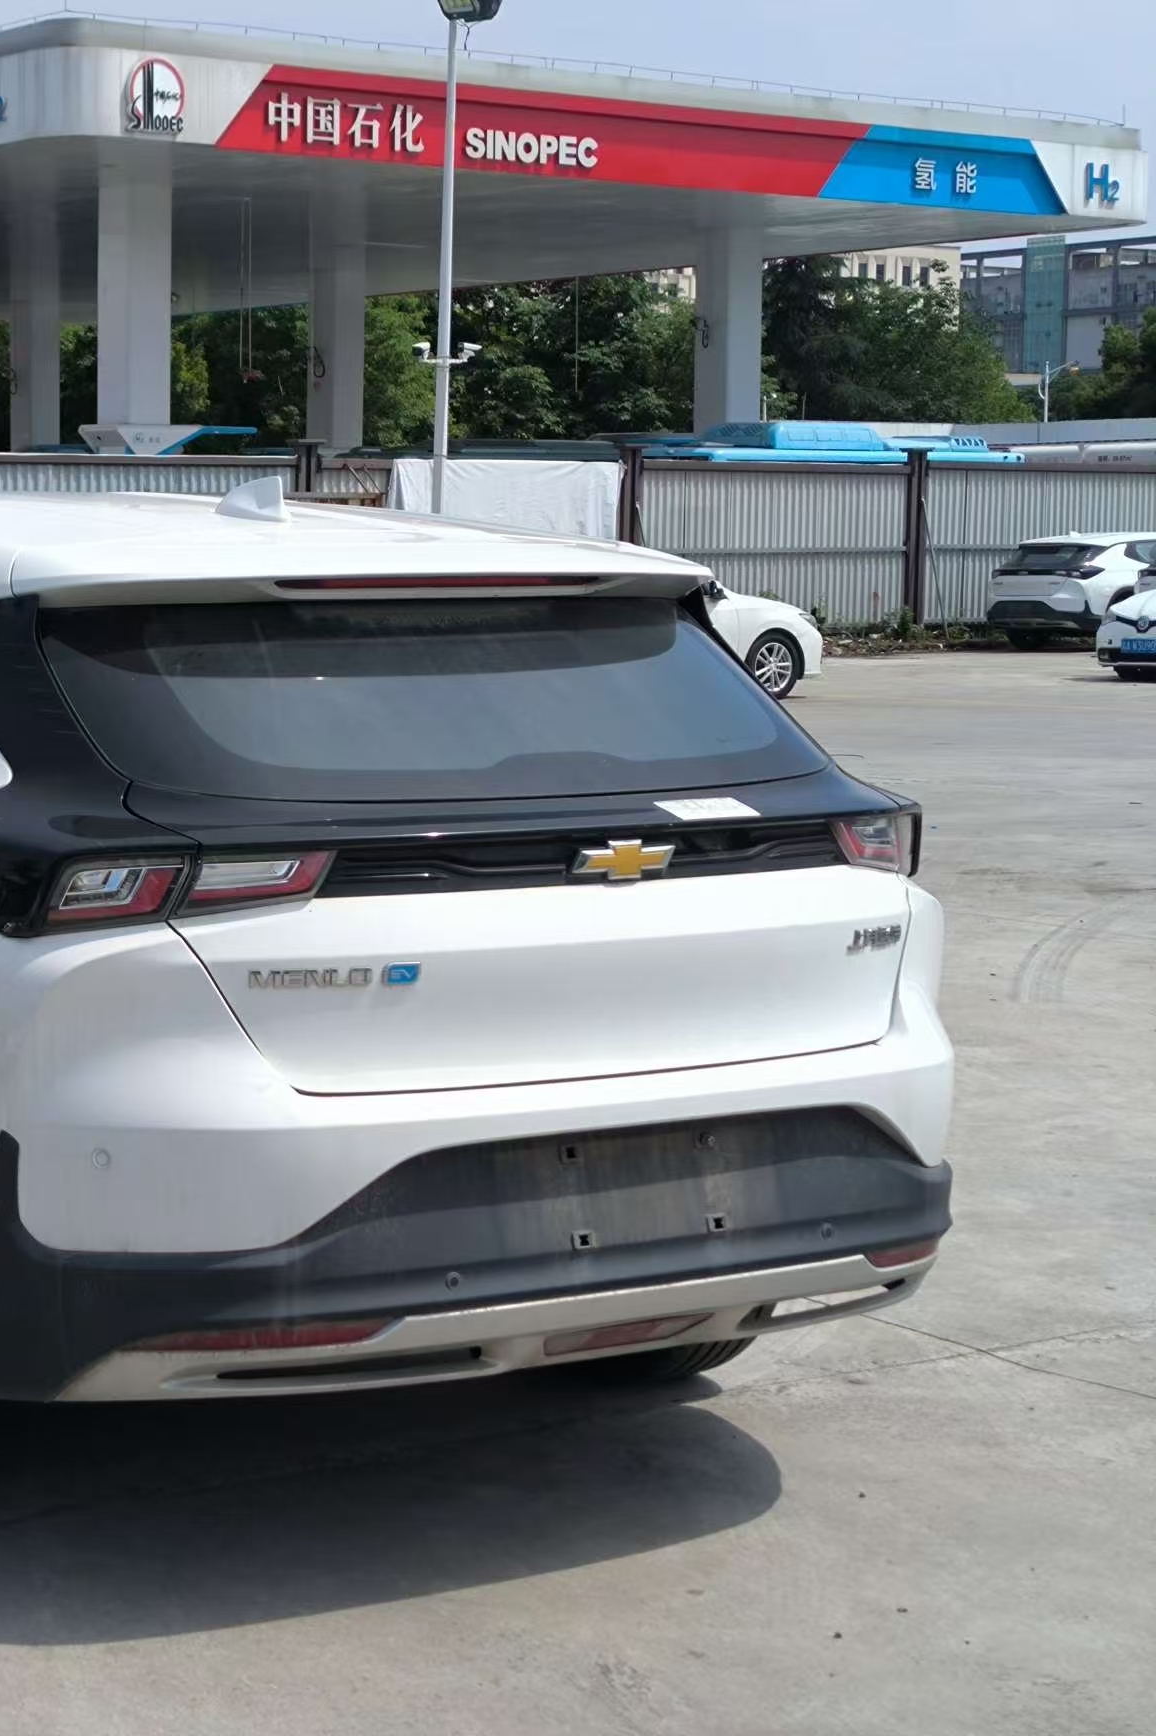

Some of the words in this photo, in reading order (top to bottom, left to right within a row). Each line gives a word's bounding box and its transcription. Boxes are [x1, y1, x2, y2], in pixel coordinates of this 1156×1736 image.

[268, 92, 425, 153] 中国石化
[465, 127, 599, 168] SINOPEC
[914, 158, 977, 194] 氢能
[248, 967, 372, 989] MENLO
